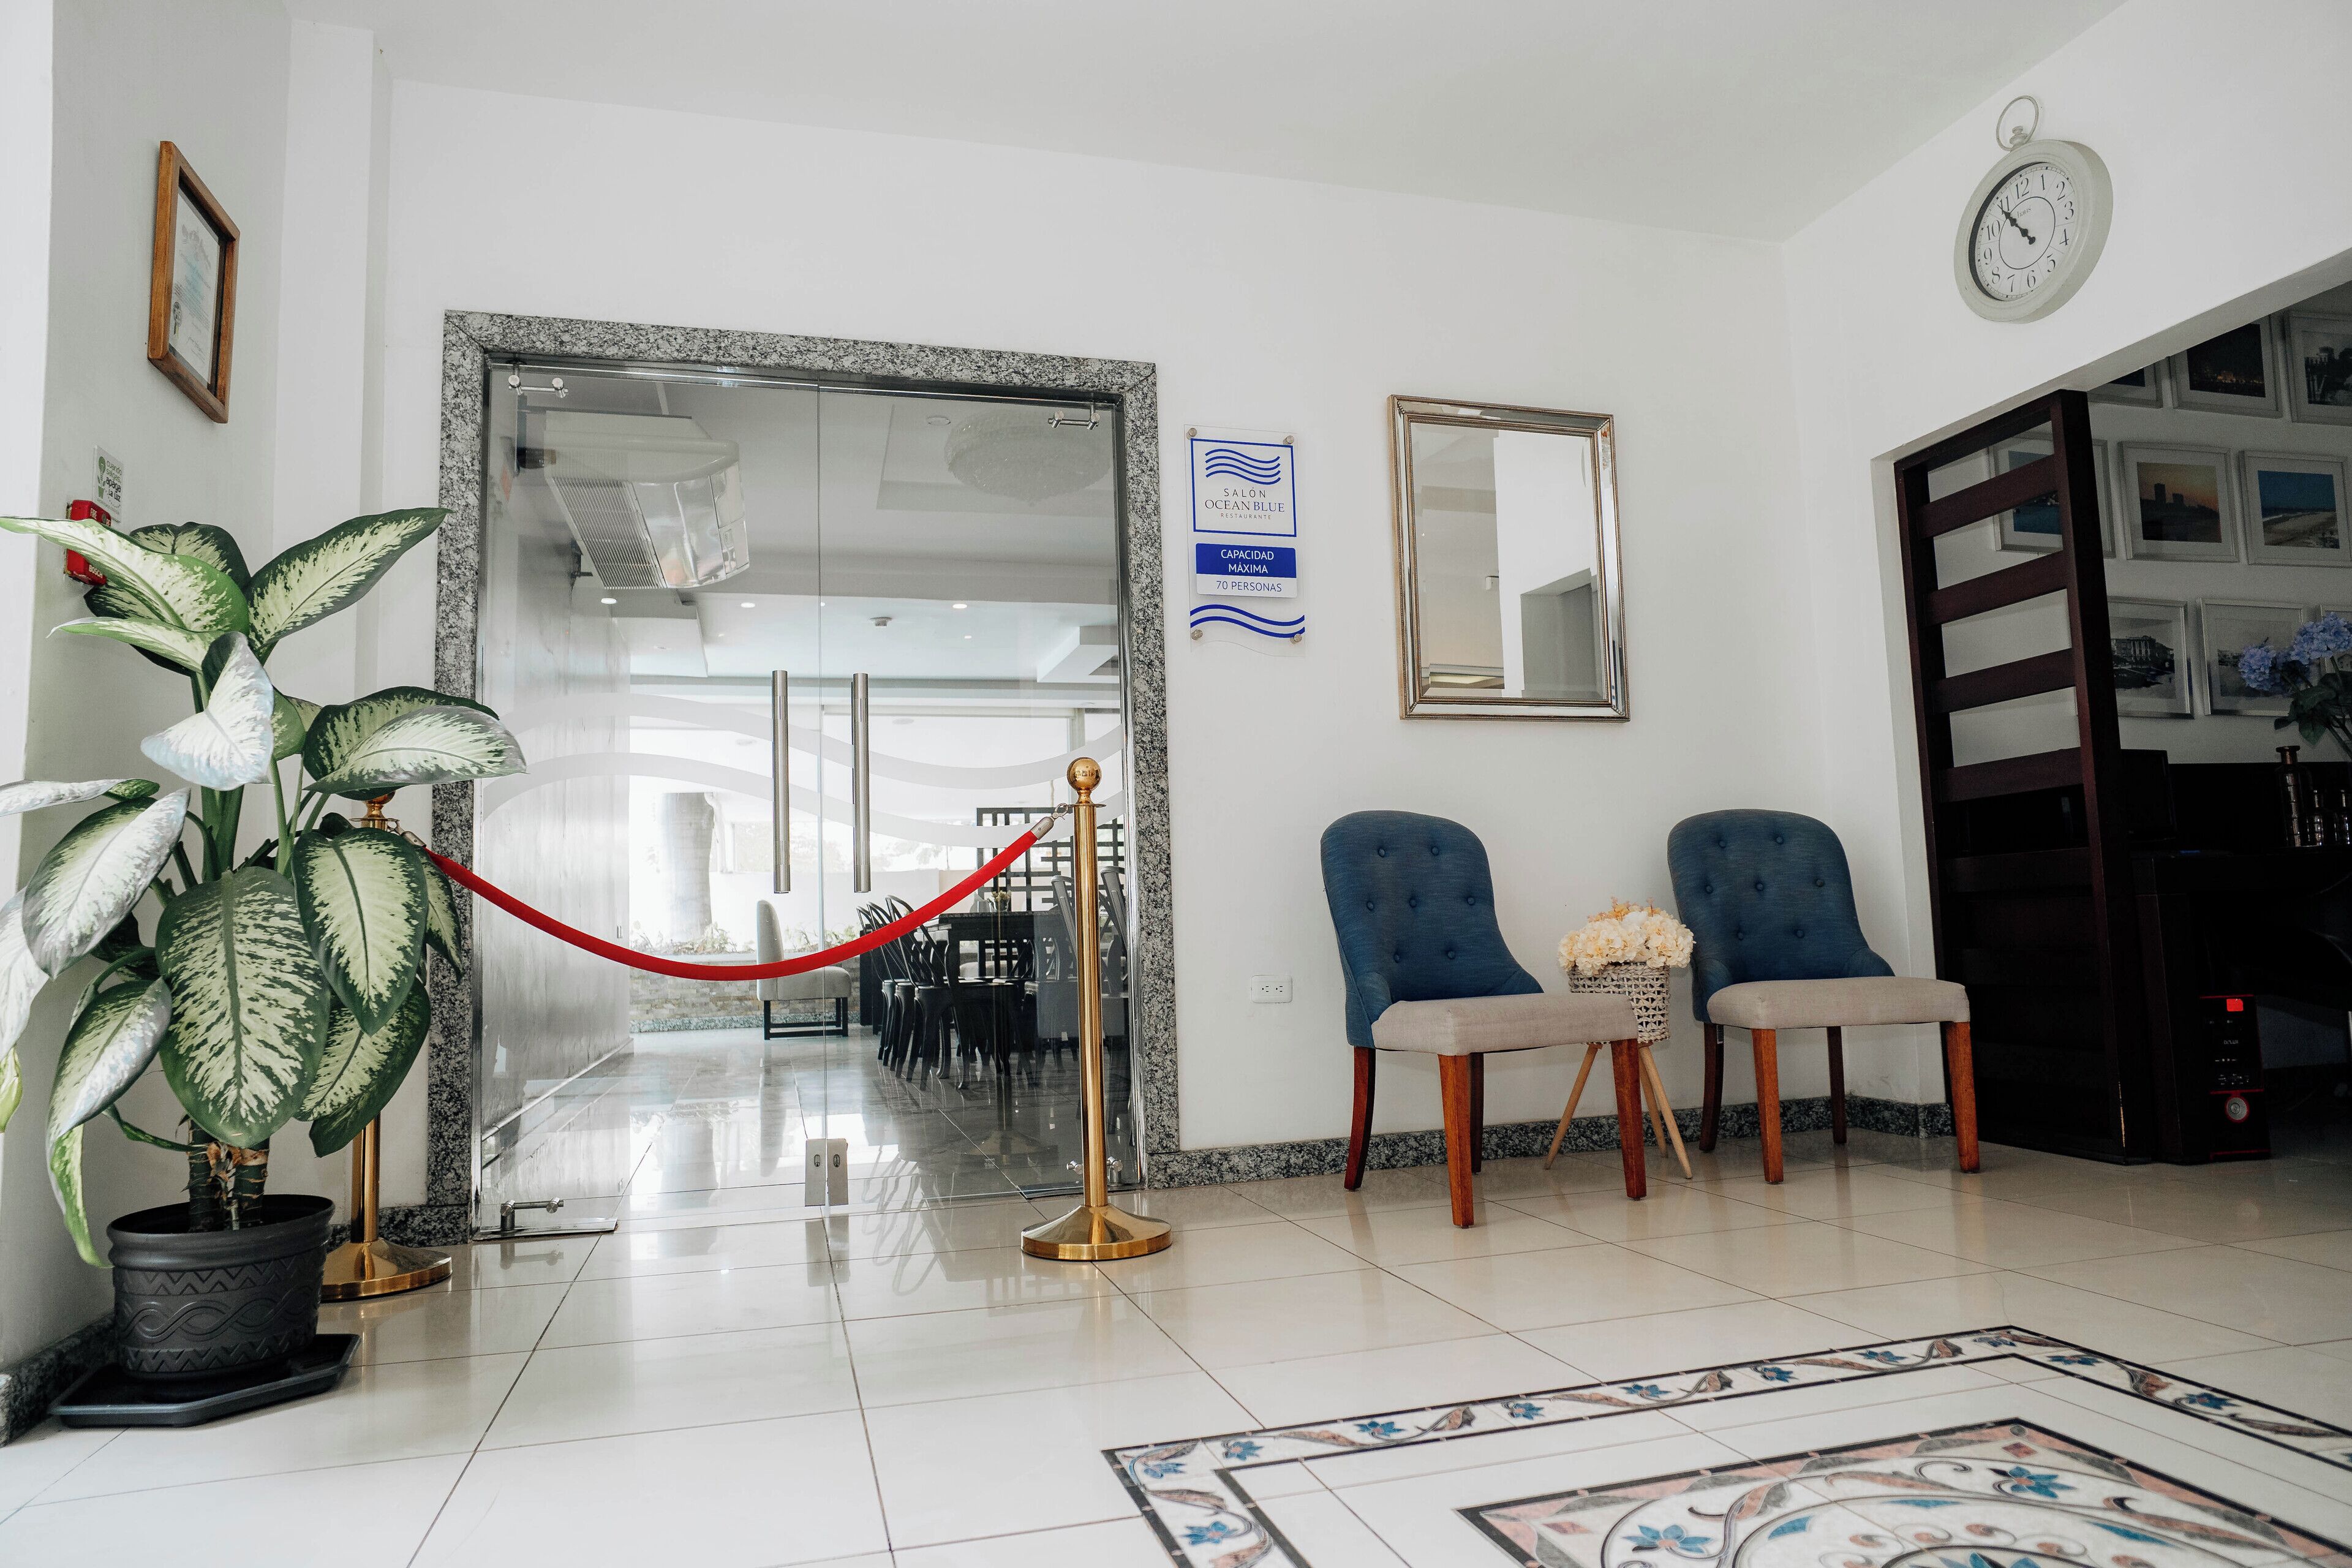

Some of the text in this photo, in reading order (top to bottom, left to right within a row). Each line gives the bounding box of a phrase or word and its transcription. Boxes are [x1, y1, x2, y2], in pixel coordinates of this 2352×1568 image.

[2015, 178, 2029, 199] 12
[2041, 174, 2045, 190] 1
[2056, 181, 2065, 201] 2
[2064, 201, 2074, 220] 3
[1986, 219, 2000, 240] 10
[2059, 228, 2069, 246] 4
[1984, 247, 1992, 265] 9
[2046, 254, 2056, 273] 5
[1991, 266, 2000, 284] 8
[2007, 274, 2015, 292] 7
[2027, 270, 2036, 288] 6
[1224, 487, 1265, 498] SALÓN
[1205, 500, 1285, 512] OCEAN BLUE
[1221, 549, 1274, 560] CAPACIDAD
[1229, 562, 1268, 573] MÁXIMA
[1216, 581, 1282, 592] 70 PERSONAS
